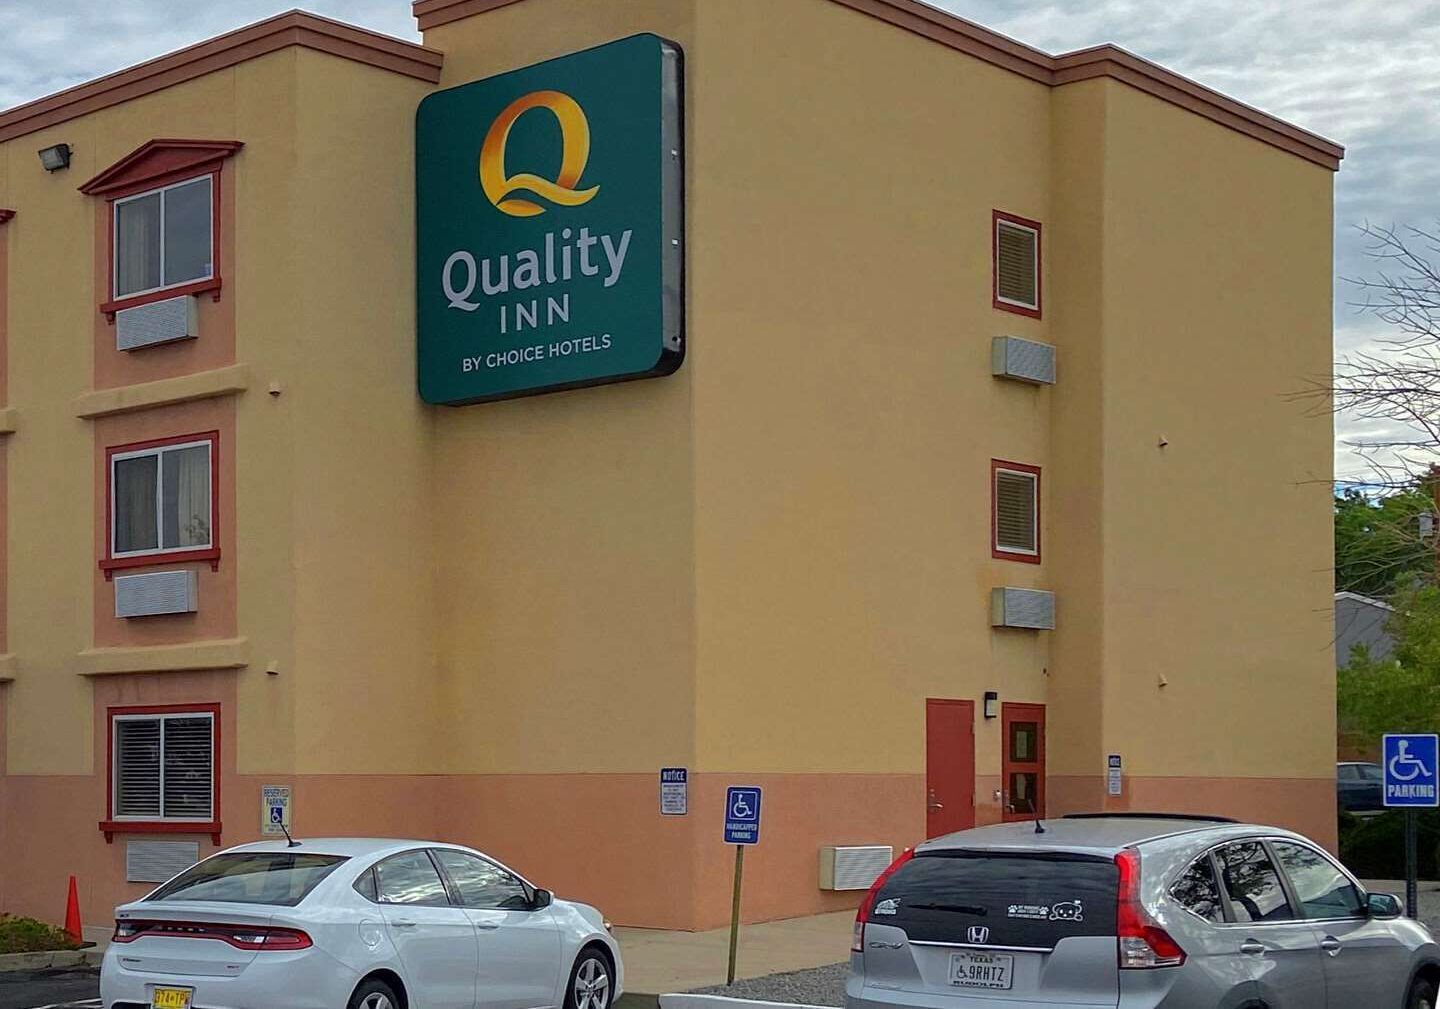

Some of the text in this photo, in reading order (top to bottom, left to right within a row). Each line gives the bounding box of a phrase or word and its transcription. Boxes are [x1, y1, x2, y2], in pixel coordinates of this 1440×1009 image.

[442, 227, 633, 312] Quality
[500, 294, 569, 334] INN
[462, 334, 612, 372] BY CHOICE HOTELS
[1387, 784, 1434, 798] PARKING
[969, 956, 993, 964] TEXAS
